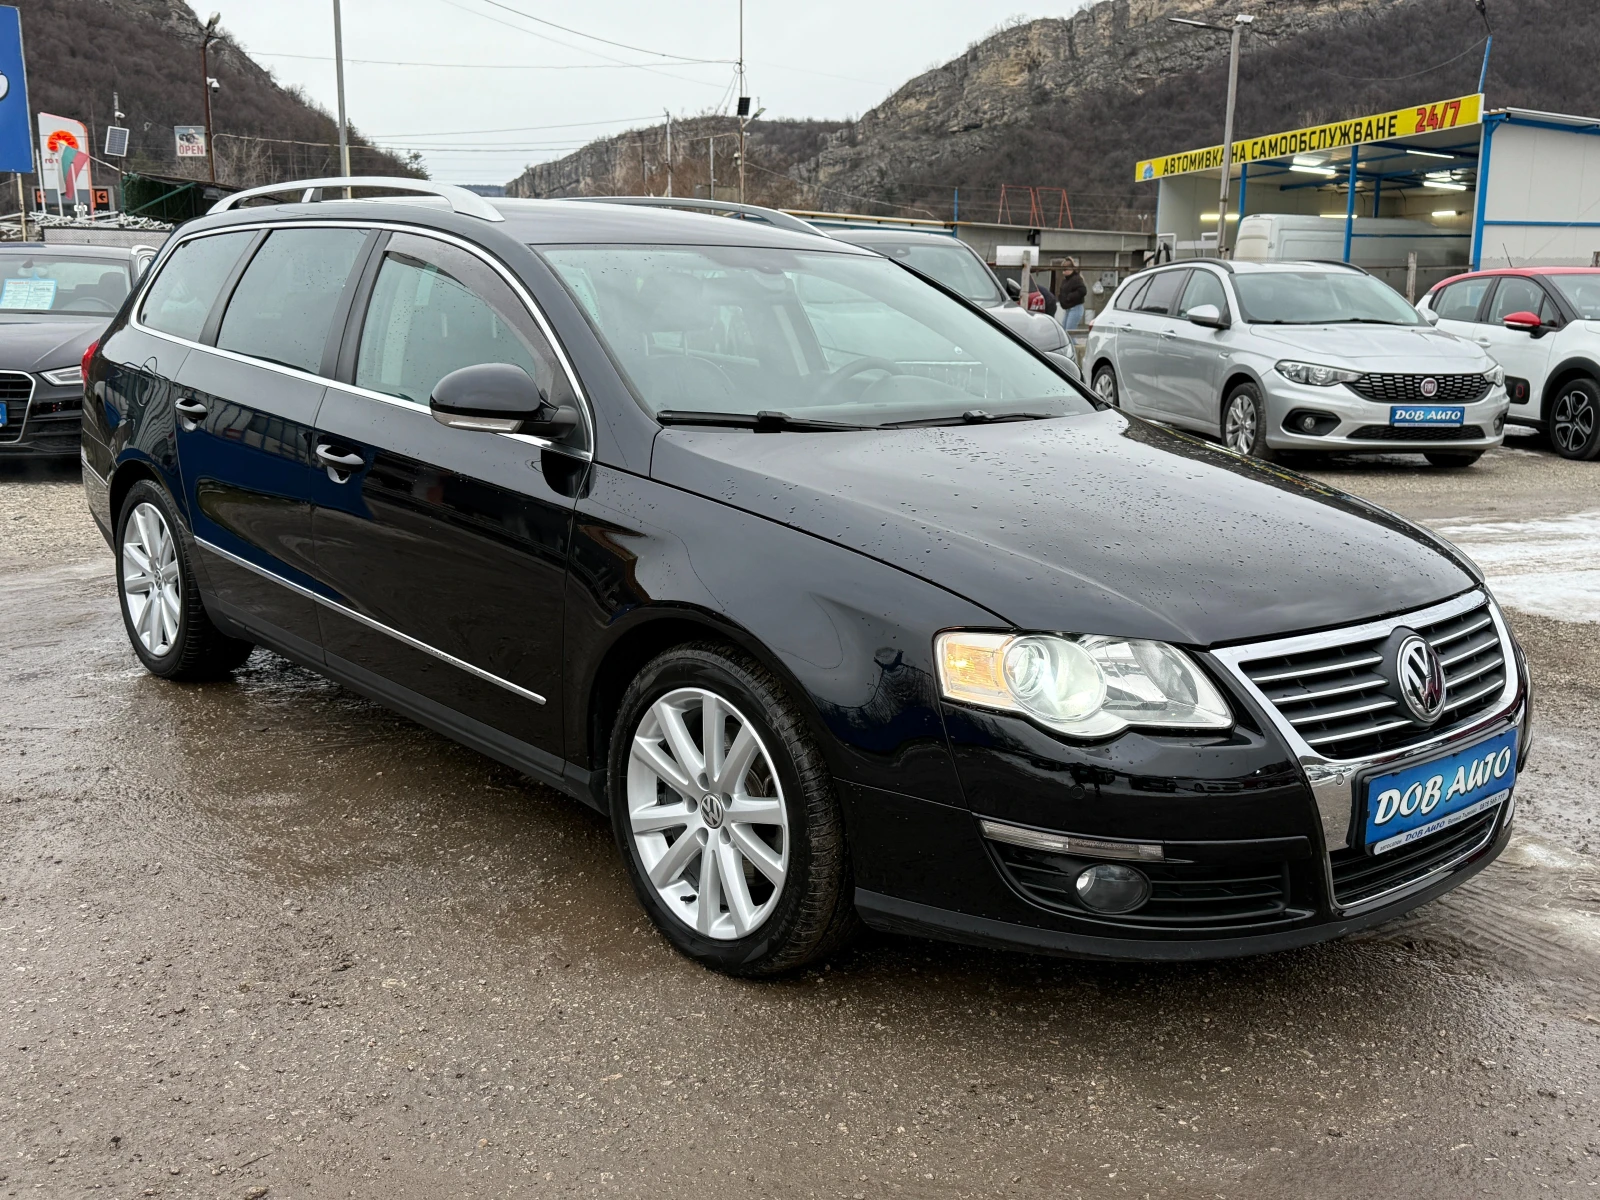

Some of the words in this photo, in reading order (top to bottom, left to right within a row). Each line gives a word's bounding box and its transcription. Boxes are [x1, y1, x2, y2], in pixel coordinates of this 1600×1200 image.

[1231, 143, 1246, 164] НА
[1251, 114, 1398, 160] САМООБСЛУЖВАНЕ
[1415, 100, 1461, 133] 24/7
[178, 144, 204, 155] OPEN
[1395, 410, 1425, 421] DOB
[1427, 411, 1460, 420] AUTO
[1374, 774, 1444, 826] DOB
[1445, 745, 1511, 801] AUTO
[1404, 830, 1423, 842] DOB
[1424, 820, 1446, 835] AUTO
